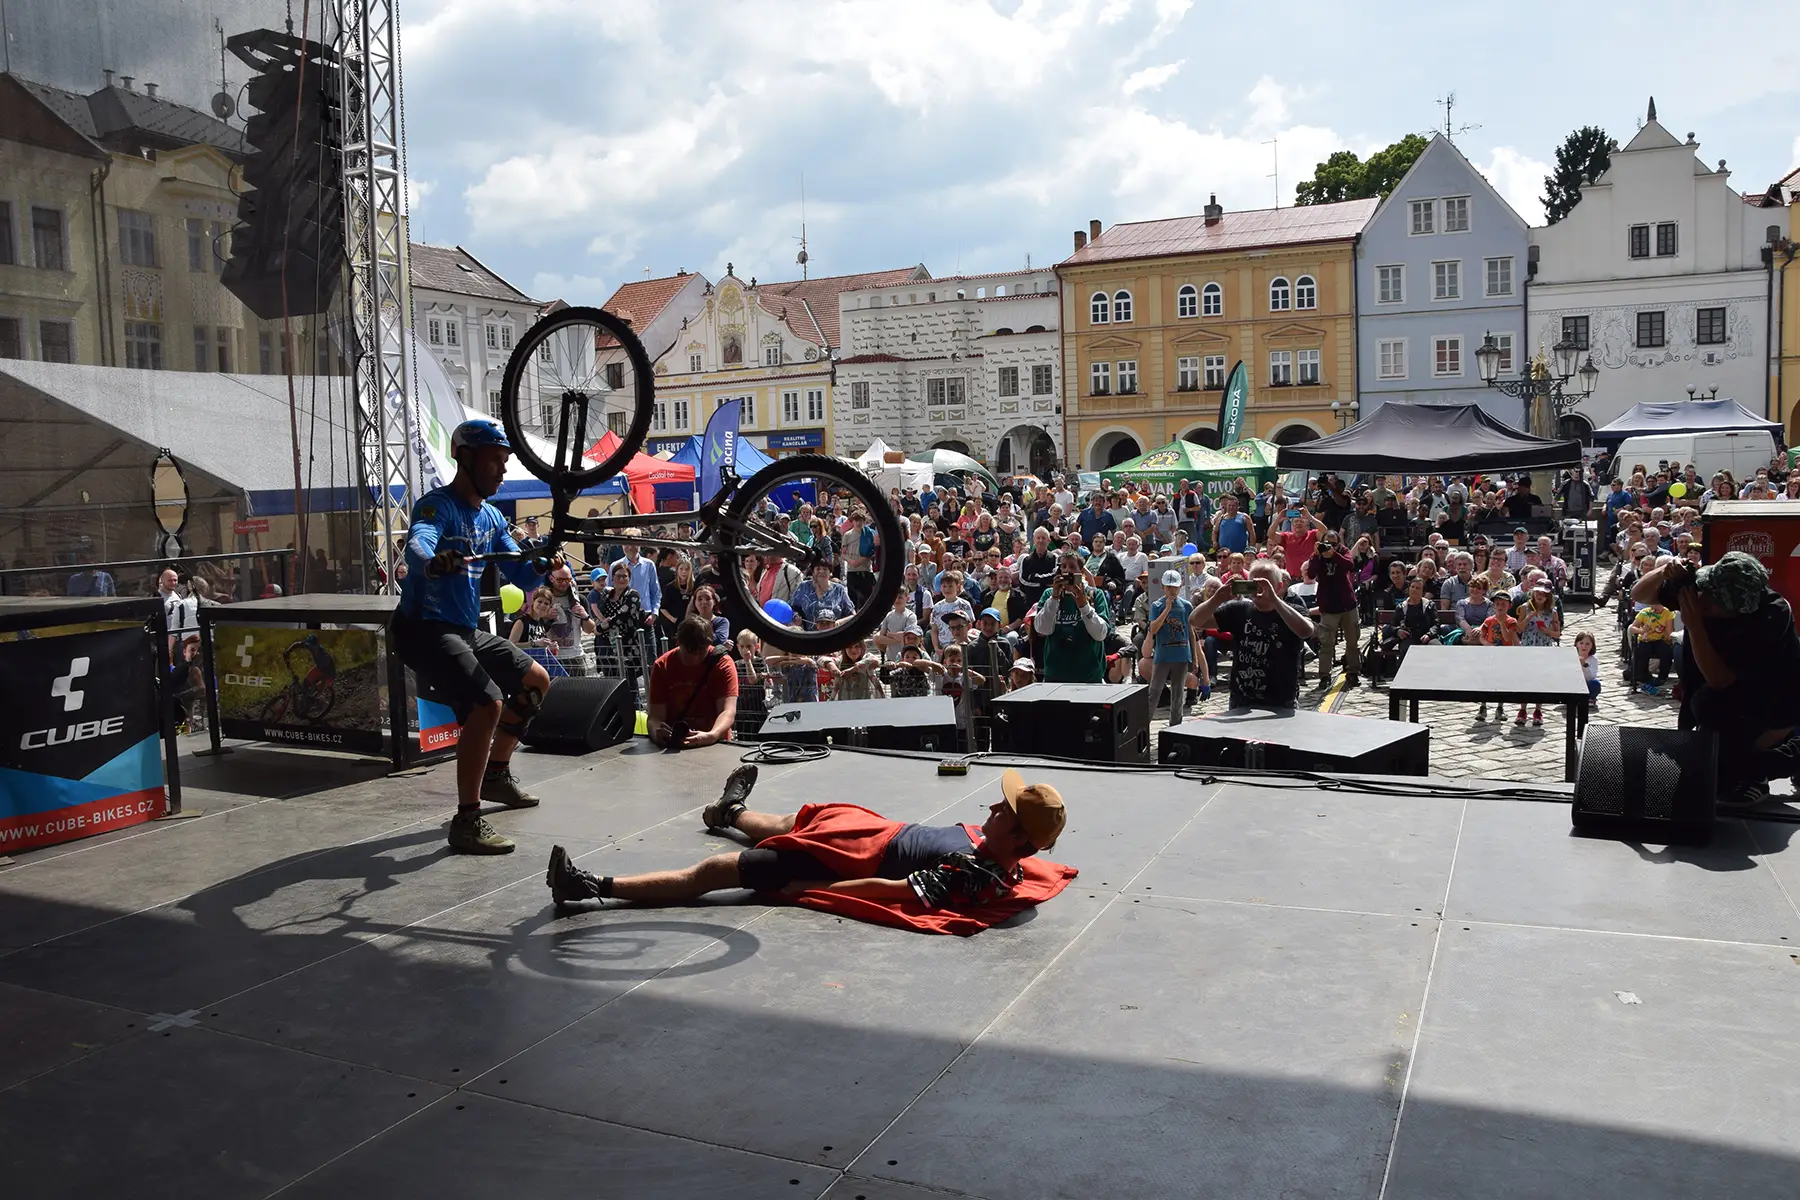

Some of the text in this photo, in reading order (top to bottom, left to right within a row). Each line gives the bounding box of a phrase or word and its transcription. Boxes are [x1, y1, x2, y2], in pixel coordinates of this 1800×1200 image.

[224, 673, 273, 688] CUBE
[19, 715, 125, 751] CUBE
[263, 728, 342, 743] WWW.CUBE-BIKES.CZ
[428, 727, 464, 744] CUBE-BI
